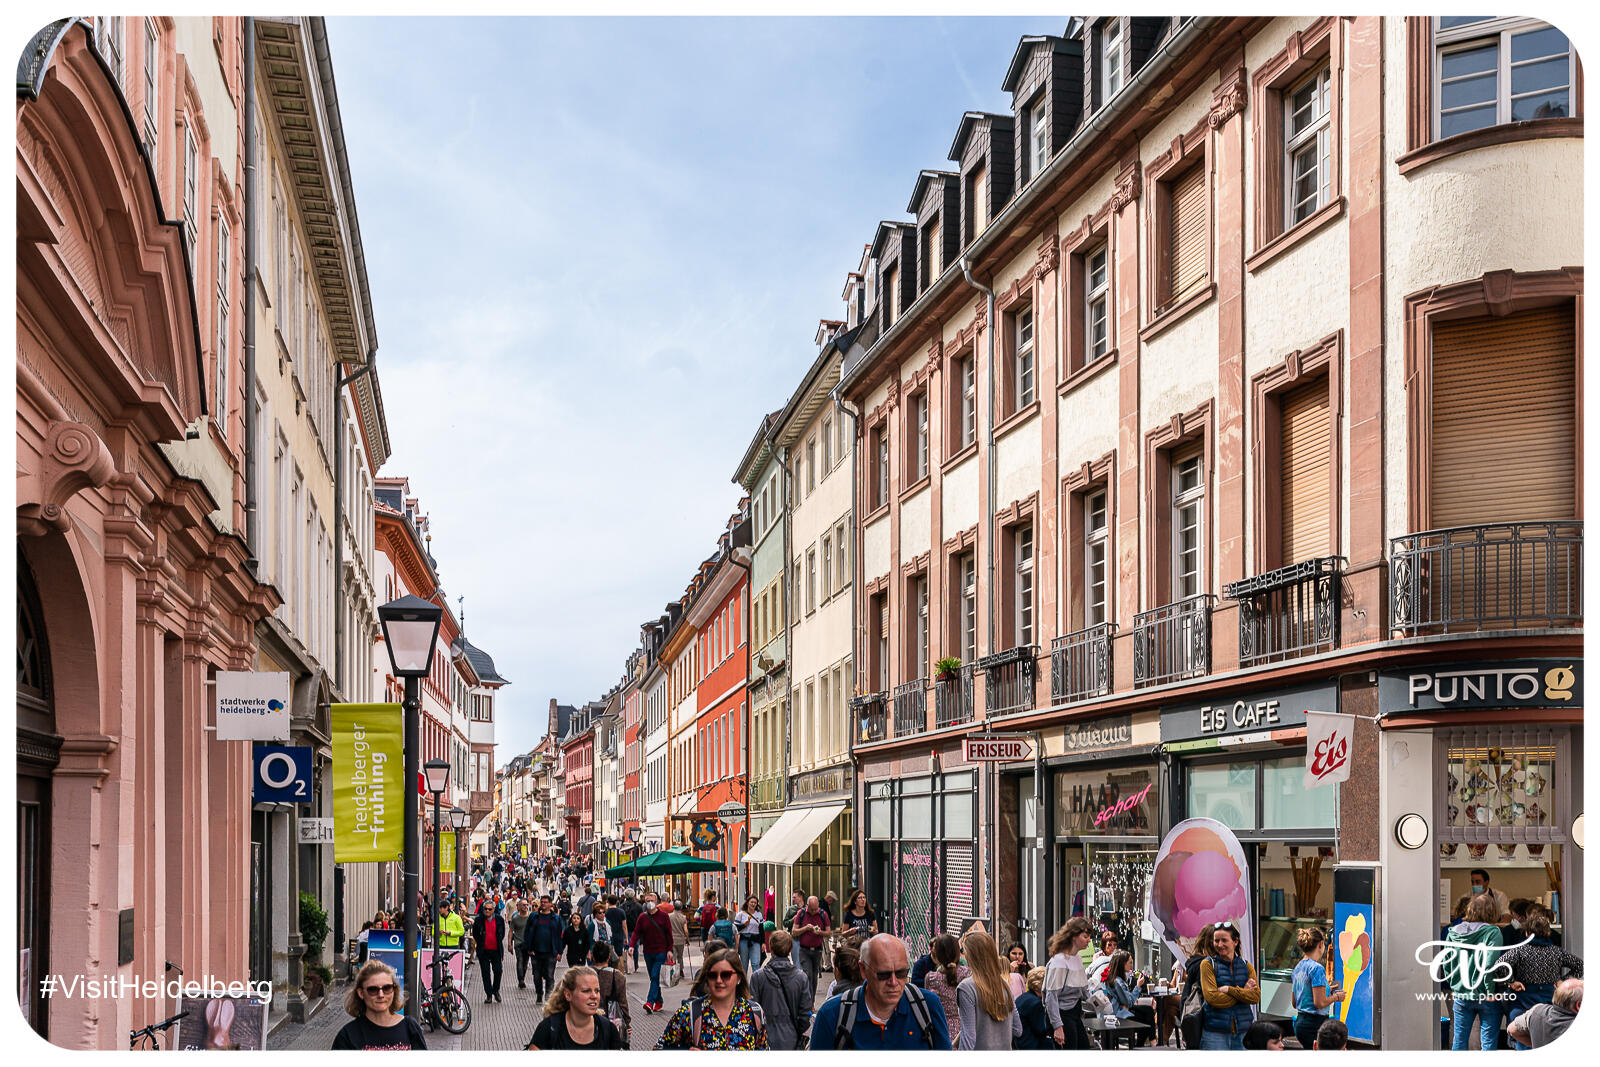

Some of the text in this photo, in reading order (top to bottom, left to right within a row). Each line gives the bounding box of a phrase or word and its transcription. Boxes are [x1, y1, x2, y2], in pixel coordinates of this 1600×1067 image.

[220, 697, 266, 706] stadtwerke
[1409, 668, 1539, 705] PUNTO
[220, 706, 266, 715] heidelberg
[1232, 700, 1279, 727] CAFE
[969, 743, 1023, 758] FRISEUR
[1311, 730, 1348, 776] Eis
[352, 722, 370, 834] heidelberger
[369, 752, 388, 848] frühling
[1072, 783, 1121, 814] HAAR
[1094, 782, 1153, 827] scharf
